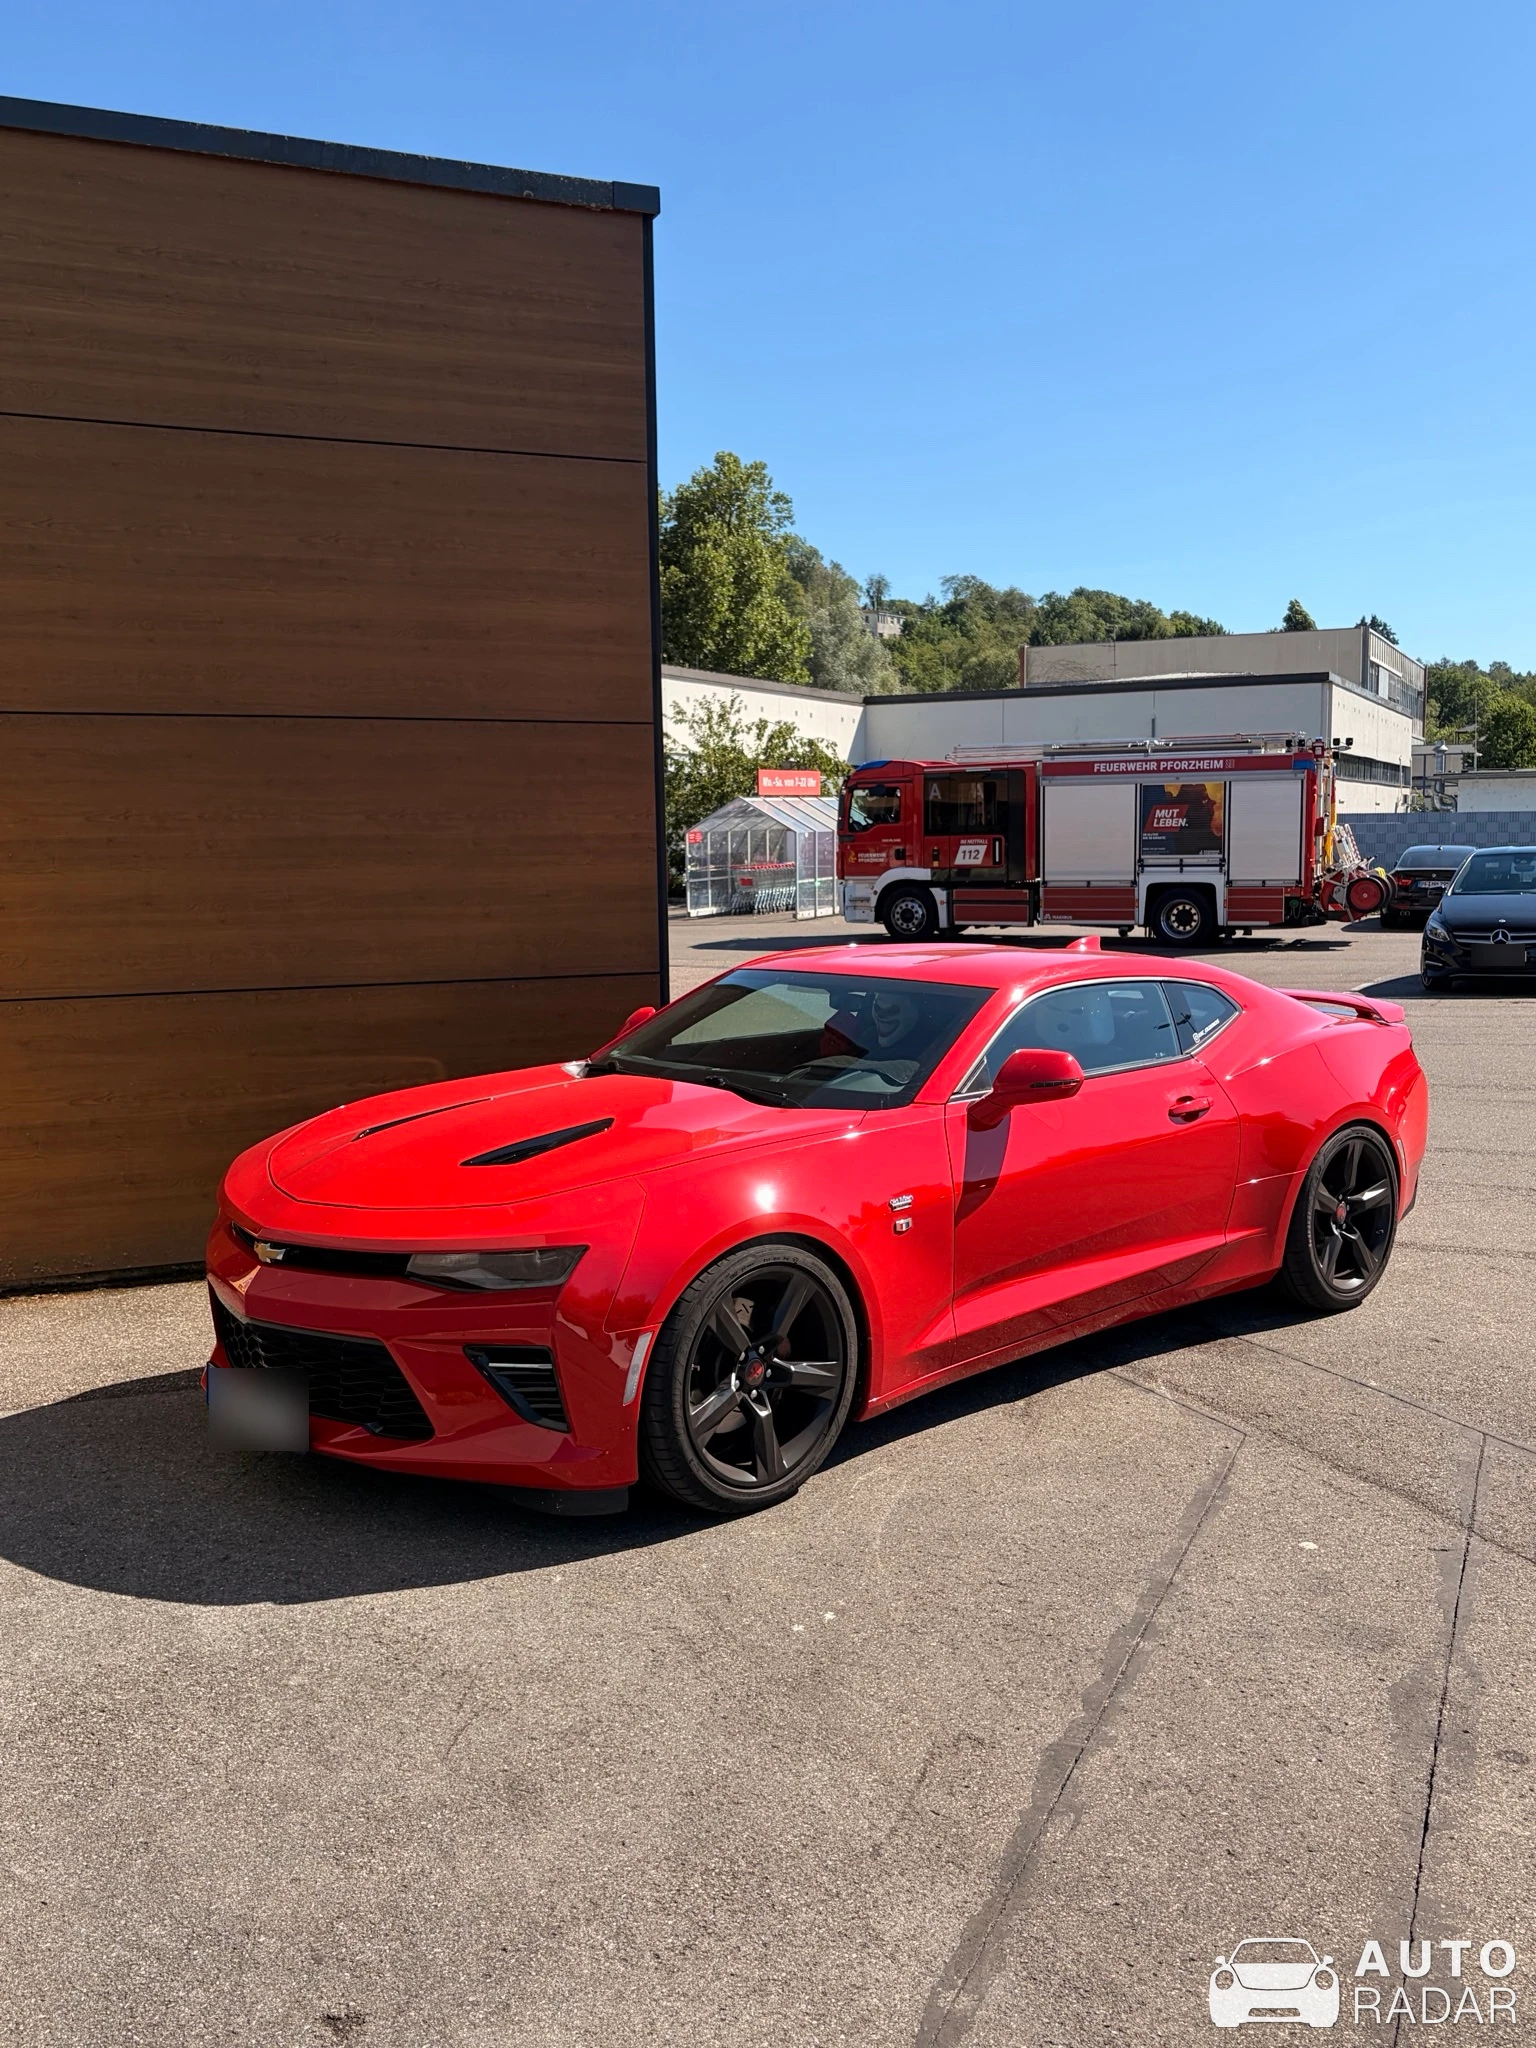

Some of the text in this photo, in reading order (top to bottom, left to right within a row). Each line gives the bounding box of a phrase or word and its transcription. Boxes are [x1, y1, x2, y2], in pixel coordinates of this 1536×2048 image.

[1094, 760, 1224, 772] FEUERWEHR PFORZHEIM
[929, 783, 942, 800] A
[1155, 809, 1180, 818] MUT
[1153, 818, 1189, 828] LEBEN.
[961, 849, 980, 860] 112
